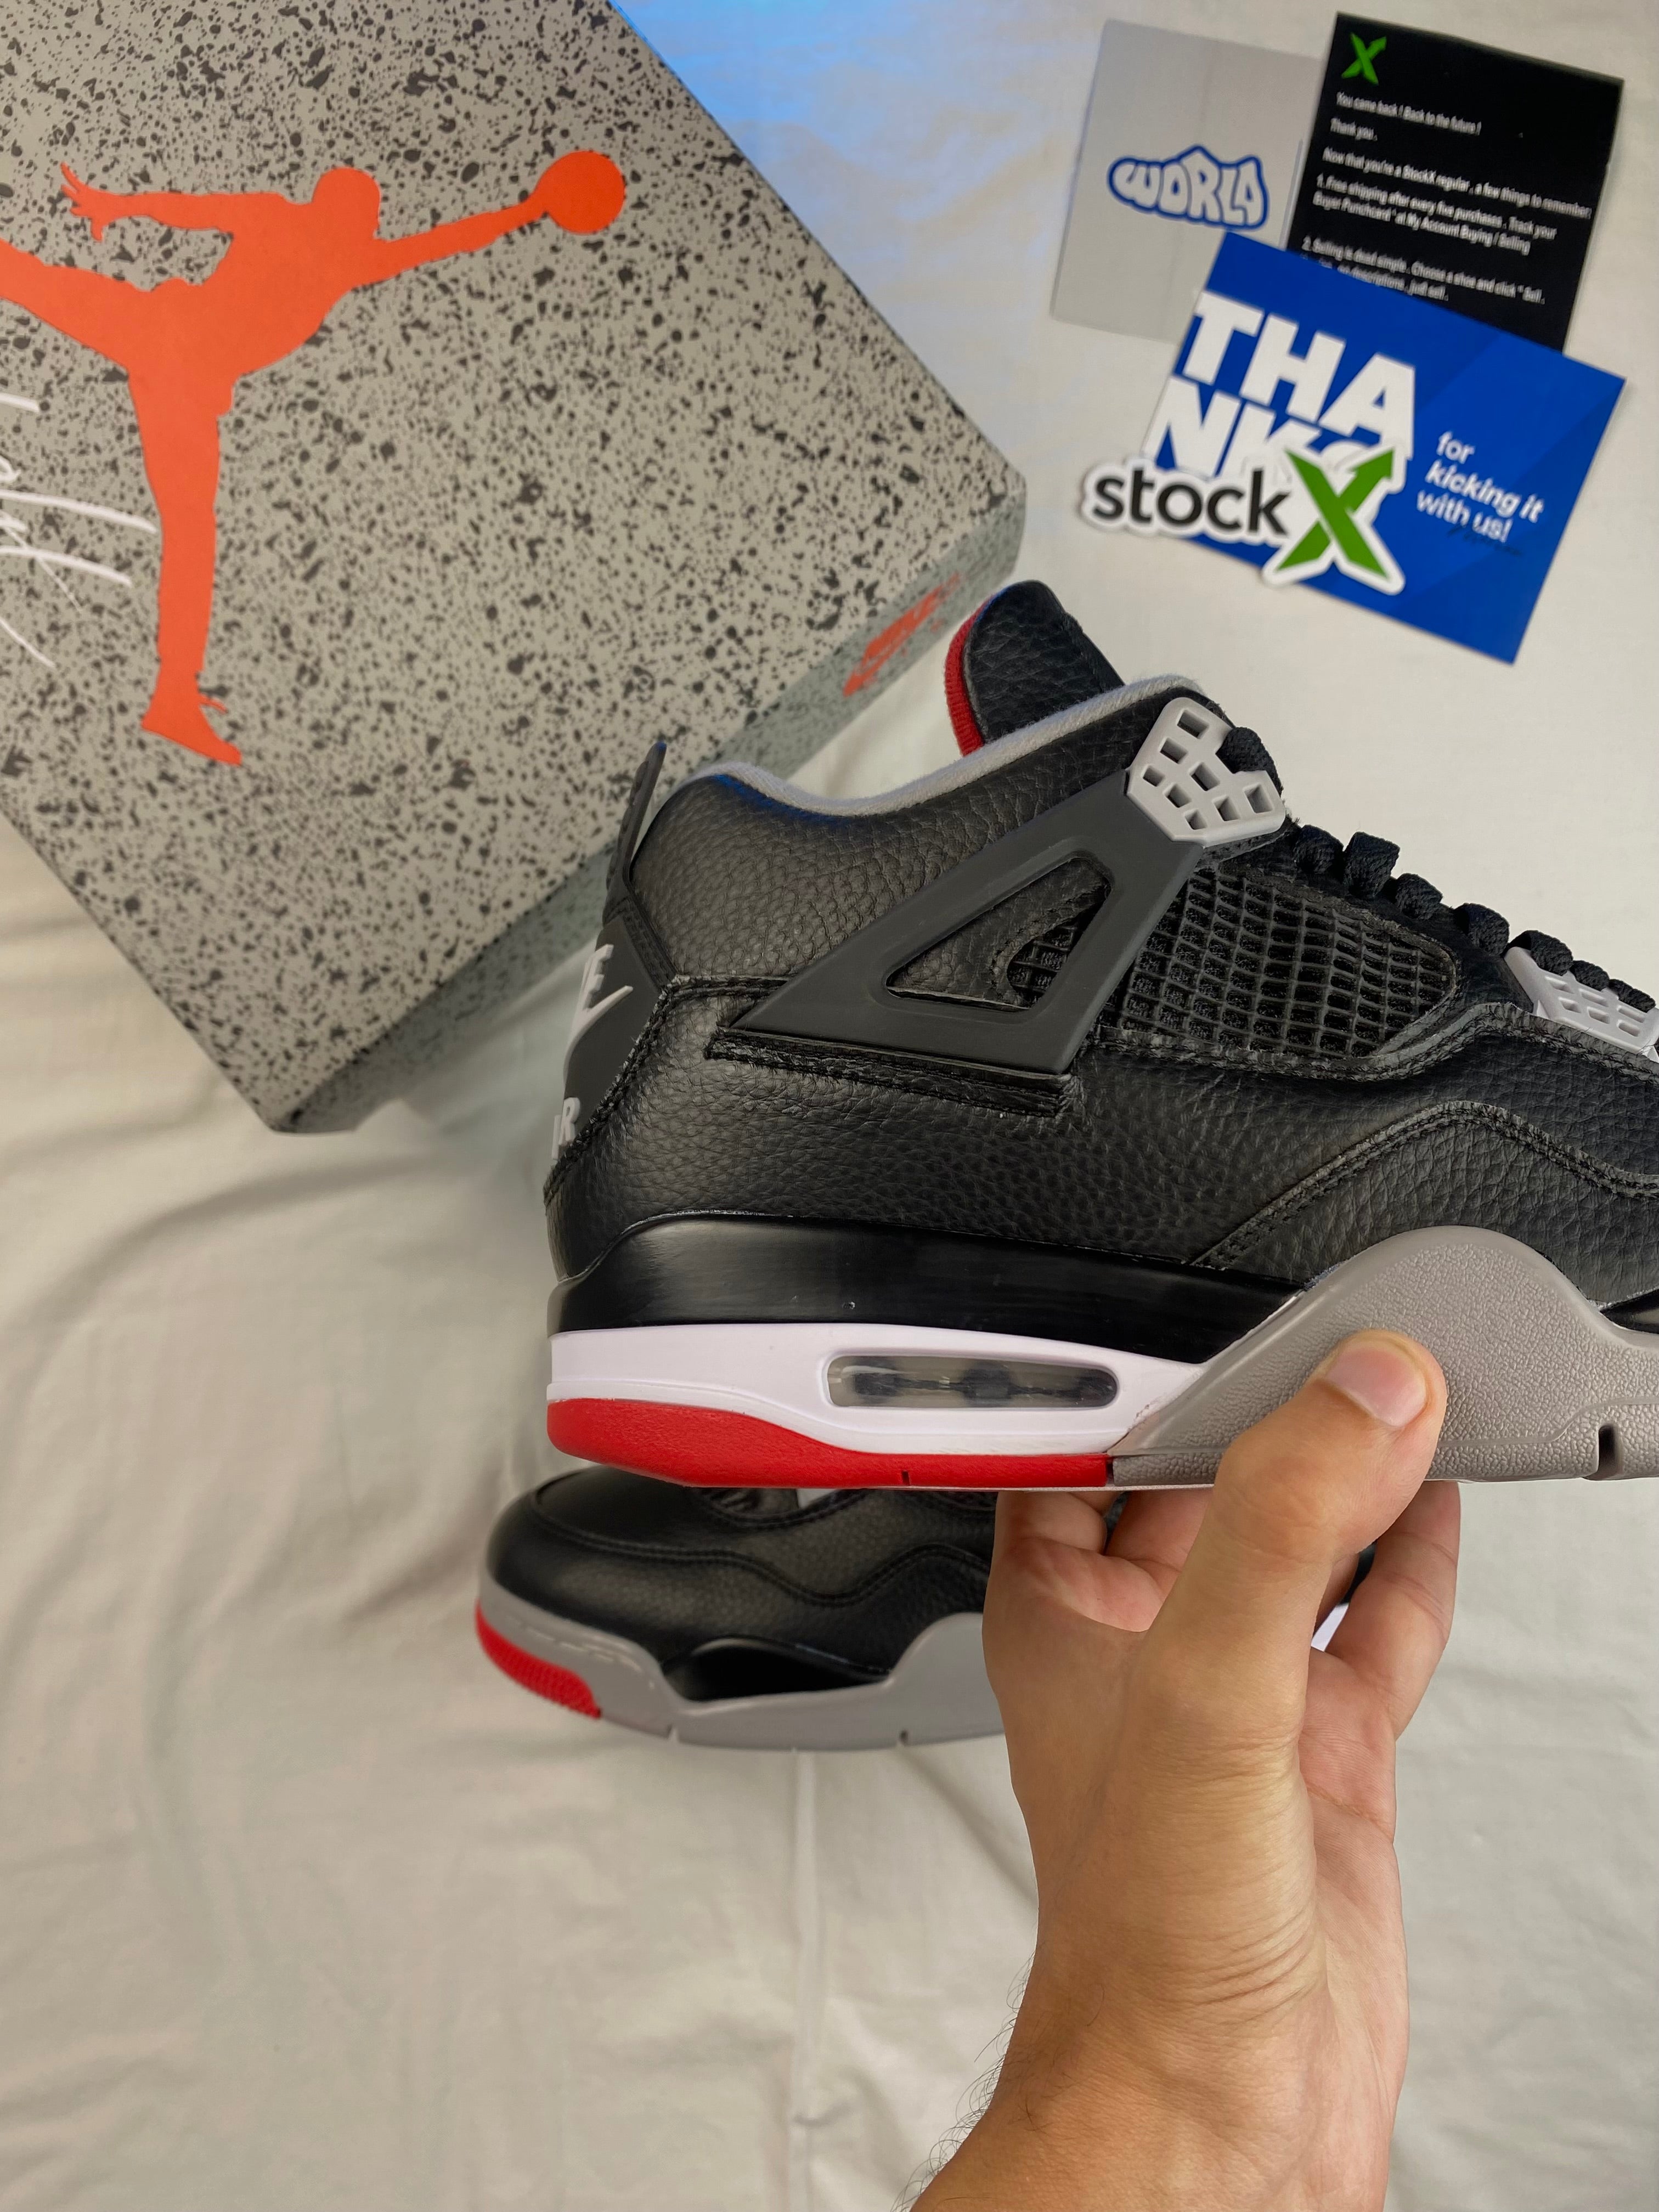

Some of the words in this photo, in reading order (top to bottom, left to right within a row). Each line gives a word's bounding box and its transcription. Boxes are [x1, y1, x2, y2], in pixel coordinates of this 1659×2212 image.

[1331, 119, 1356, 135] Thank
[1337, 92, 1353, 108] You
[1353, 98, 1376, 112] came
[1403, 106, 1424, 122] Back
[1425, 112, 1435, 125] to
[1435, 114, 1449, 128] the
[1323, 148, 1345, 163] Now
[1345, 153, 1364, 168] that
[1394, 166, 1401, 177] a
[1475, 184, 1482, 195] a
[1482, 183, 1500, 198] few
[1500, 187, 1530, 207] things
[1531, 194, 1542, 207] to
[1348, 183, 1387, 205] shipping
[1509, 217, 1533, 234] Track
[1533, 225, 1556, 239] your
[1420, 217, 1460, 237] Account
[1412, 262, 1446, 281] Choose
[1446, 272, 1453, 283] a
[1476, 279, 1495, 292] and
[1182, 291, 1415, 459] THA
[1142, 375, 1372, 480] NK
[1436, 431, 1475, 464] for
[1417, 490, 1471, 528] with
[1472, 512, 1513, 543] us!
[1425, 459, 1522, 518] kicking
[1519, 494, 1544, 523] it
